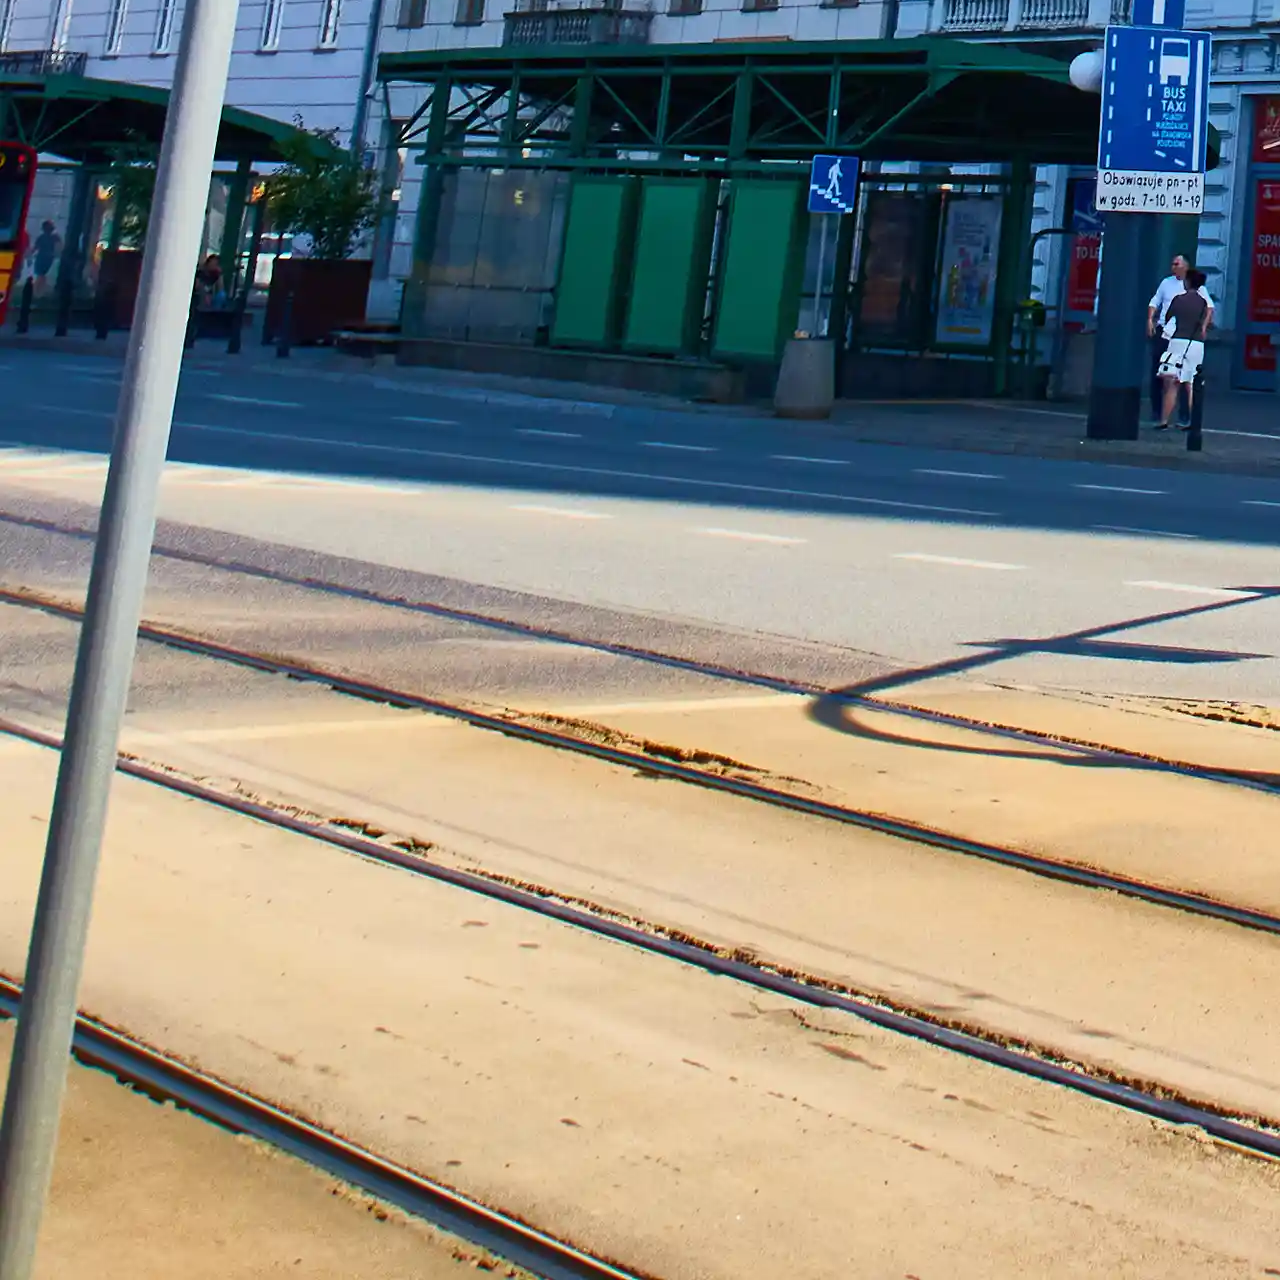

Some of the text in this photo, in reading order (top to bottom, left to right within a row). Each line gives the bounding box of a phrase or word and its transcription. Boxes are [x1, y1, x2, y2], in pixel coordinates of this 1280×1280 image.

[1163, 86, 1186, 99] BUS
[1161, 100, 1186, 112] TAXI
[1166, 176, 1198, 192] pn-pt
[1099, 197, 1107, 205] w
[1172, 194, 1201, 209] 14-19
[1076, 246, 1088, 259] TO
[1256, 253, 1273, 268] TO
